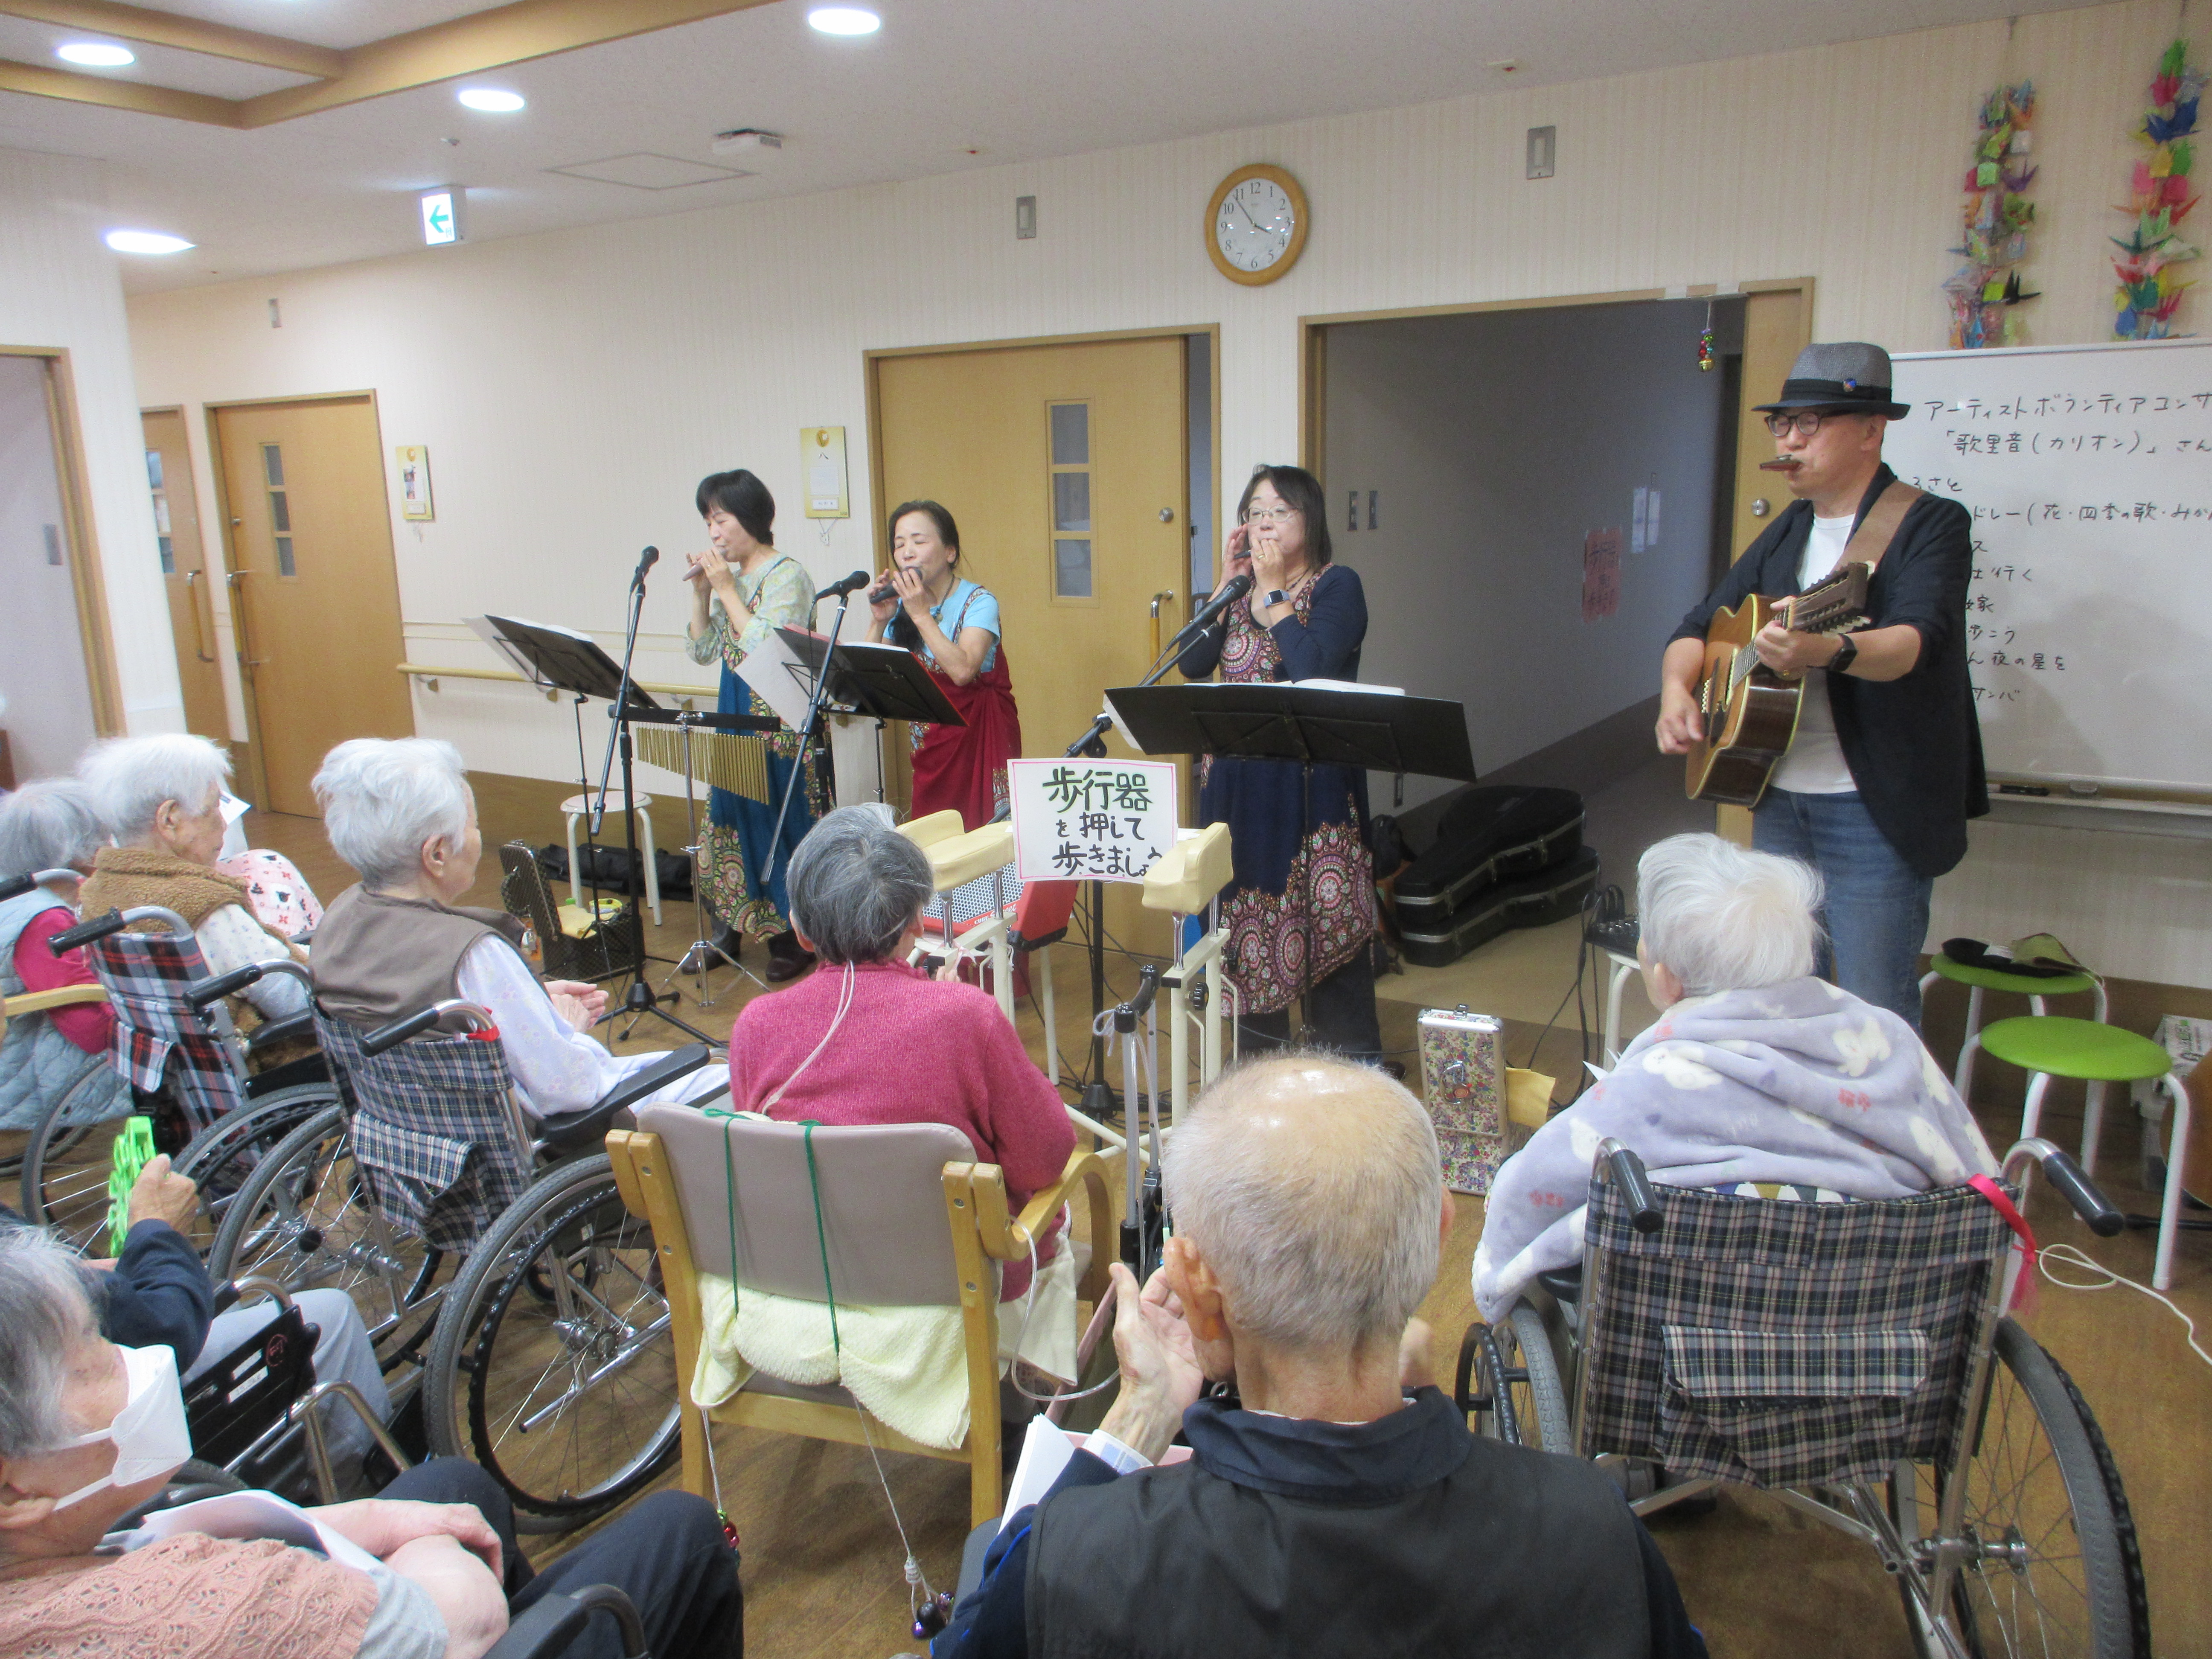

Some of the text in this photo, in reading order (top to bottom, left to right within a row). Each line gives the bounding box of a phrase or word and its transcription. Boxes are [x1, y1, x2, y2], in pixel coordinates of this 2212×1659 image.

[1250, 182, 1260, 194] 12
[1235, 189, 1244, 200] 11
[1223, 203, 1234, 214] 10
[1279, 198, 1286, 210] 2
[1221, 222, 1227, 234] 9
[1284, 216, 1290, 228] 3
[1225, 240, 1231, 251] 8
[1278, 235, 1285, 247] 4
[1236, 252, 1243, 264] 7
[1251, 256, 1258, 269] 6
[1268, 250, 1274, 263] 5
[1042, 766, 1153, 813] 歩行器
[1055, 812, 1145, 842] を押して
